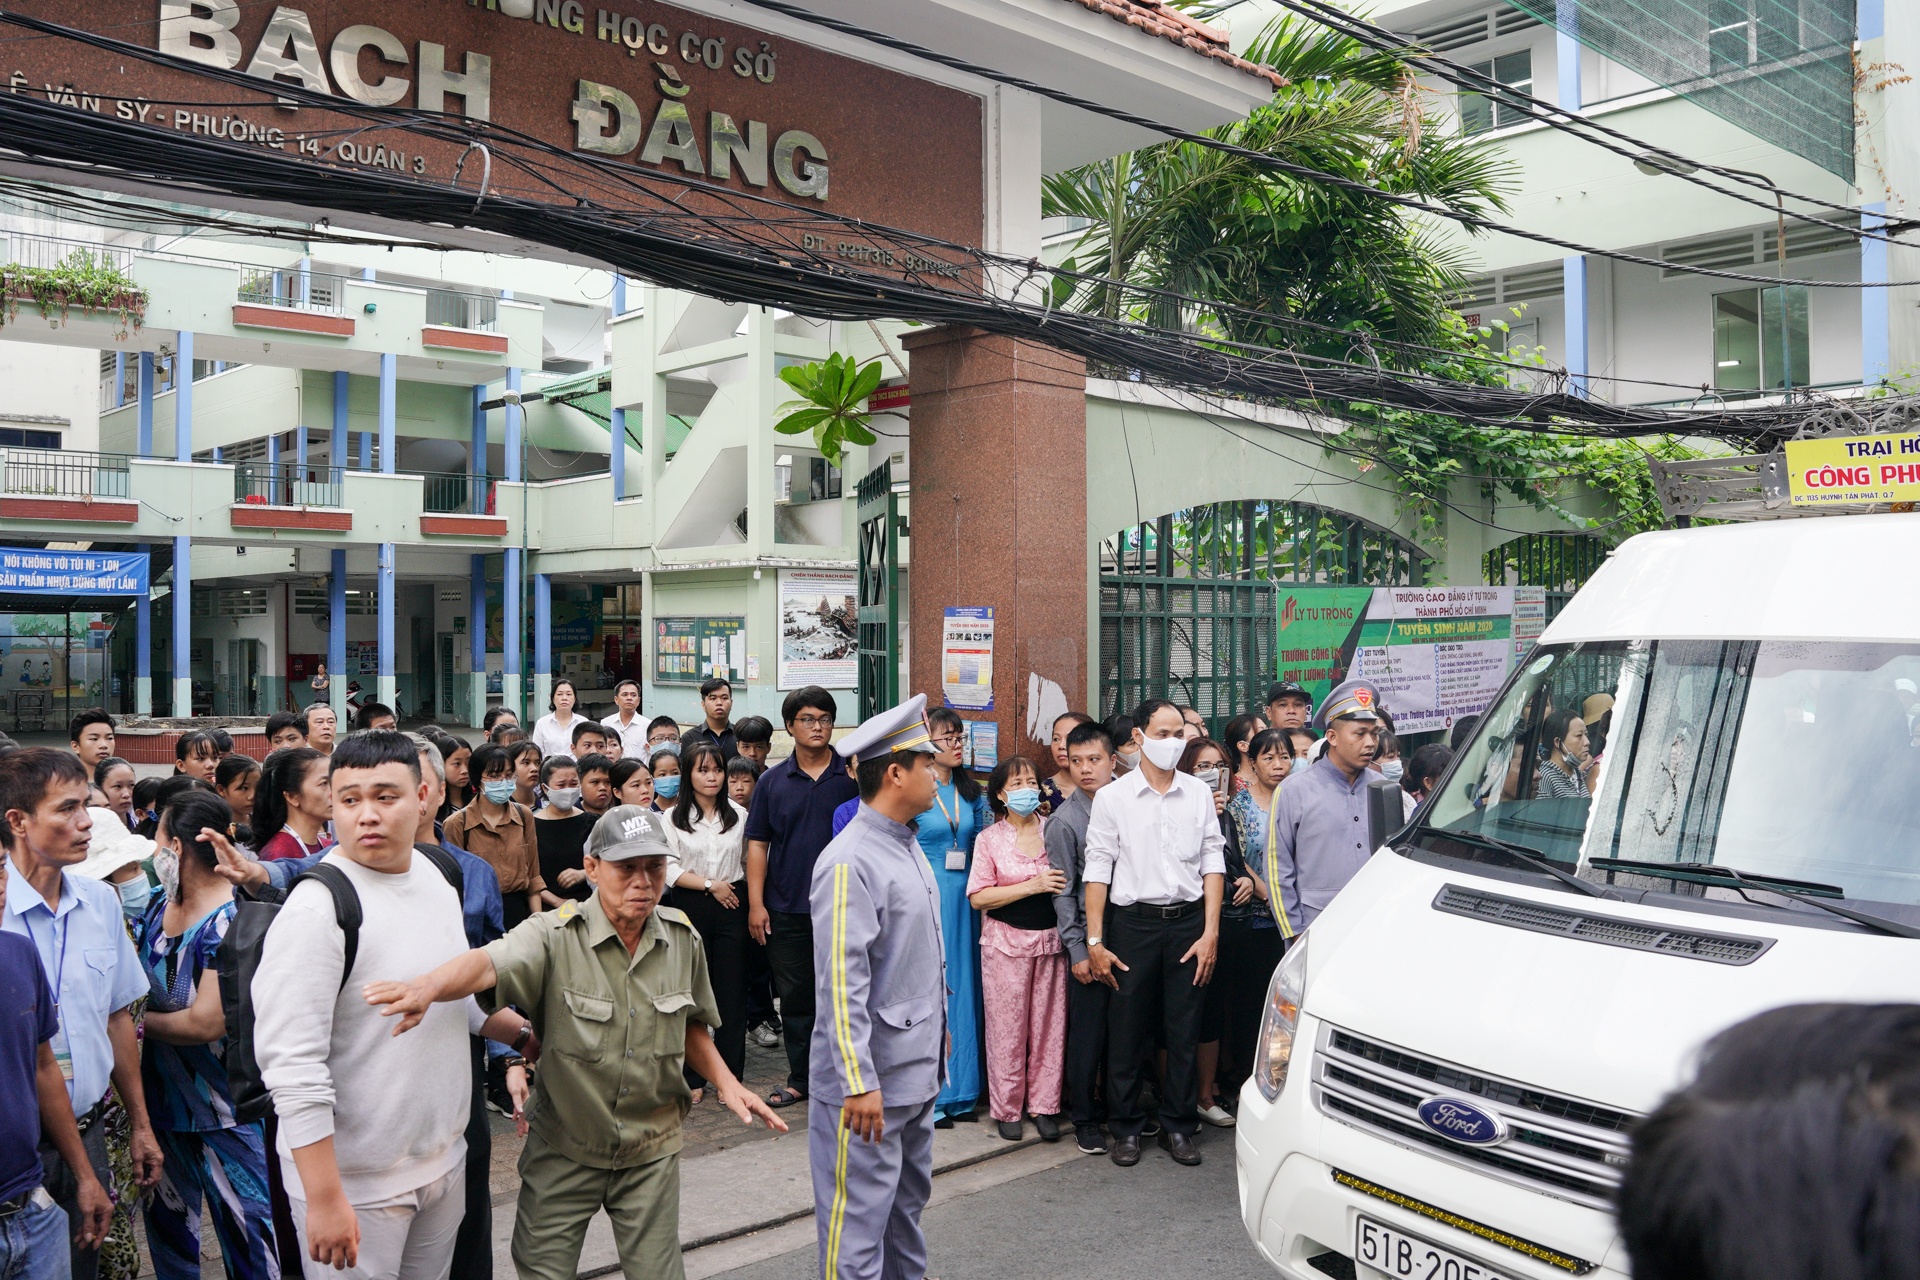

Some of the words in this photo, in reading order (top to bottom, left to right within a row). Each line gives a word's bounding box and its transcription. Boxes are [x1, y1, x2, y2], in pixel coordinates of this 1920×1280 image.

[598, 8, 668, 57] HỌC
[679, 31, 726, 70] CƠ
[731, 40, 778, 84] SỞ
[158, 0, 492, 122] BẠCH
[572, 61, 830, 201] ĐẰNG
[175, 108, 285, 149] PHƯỜNG
[297, 134, 320, 156] 14
[413, 154, 427, 174] 3
[1845, 440, 1892, 459] TRẠI
[1805, 465, 1870, 488] CÔNG
[4, 553, 20, 568] NÓI
[22, 555, 52, 570] KHÔNG
[54, 556, 69, 570] VỚI
[70, 556, 83, 571] TÚI
[86, 560, 95, 571] NI
[102, 560, 119, 572] LON
[20, 571, 45, 588] PHẨM
[46, 575, 70, 590] NHỰA
[73, 574, 96, 589] DÙNG
[98, 576, 117, 591] MỘT
[118, 574, 137, 590] LẦN!
[1395, 591, 1425, 603] TRƯỜNG
[1426, 592, 1446, 603] CAO
[1467, 590, 1474, 601] LÝ
[1294, 608, 1305, 621] LY
[1307, 608, 1319, 621] TU
[1321, 607, 1353, 620] TRONG
[1415, 606, 1437, 617] THÀNH
[1439, 603, 1454, 617] PHỐ
[1455, 602, 1463, 615] HỒ
[1397, 618, 1431, 636] TUYỂN
[1434, 622, 1455, 634] SINH
[1457, 620, 1476, 633] NĂM
[1477, 620, 1493, 632] 2020
[1281, 647, 1309, 663] TRƯỜNG
[1311, 646, 1330, 660] CÔNG
[1283, 667, 1303, 682] CHẤT
[1304, 667, 1326, 683] LƯỢNG
[621, 815, 650, 832] WIX
[1431, 1102, 1482, 1136] Ford
